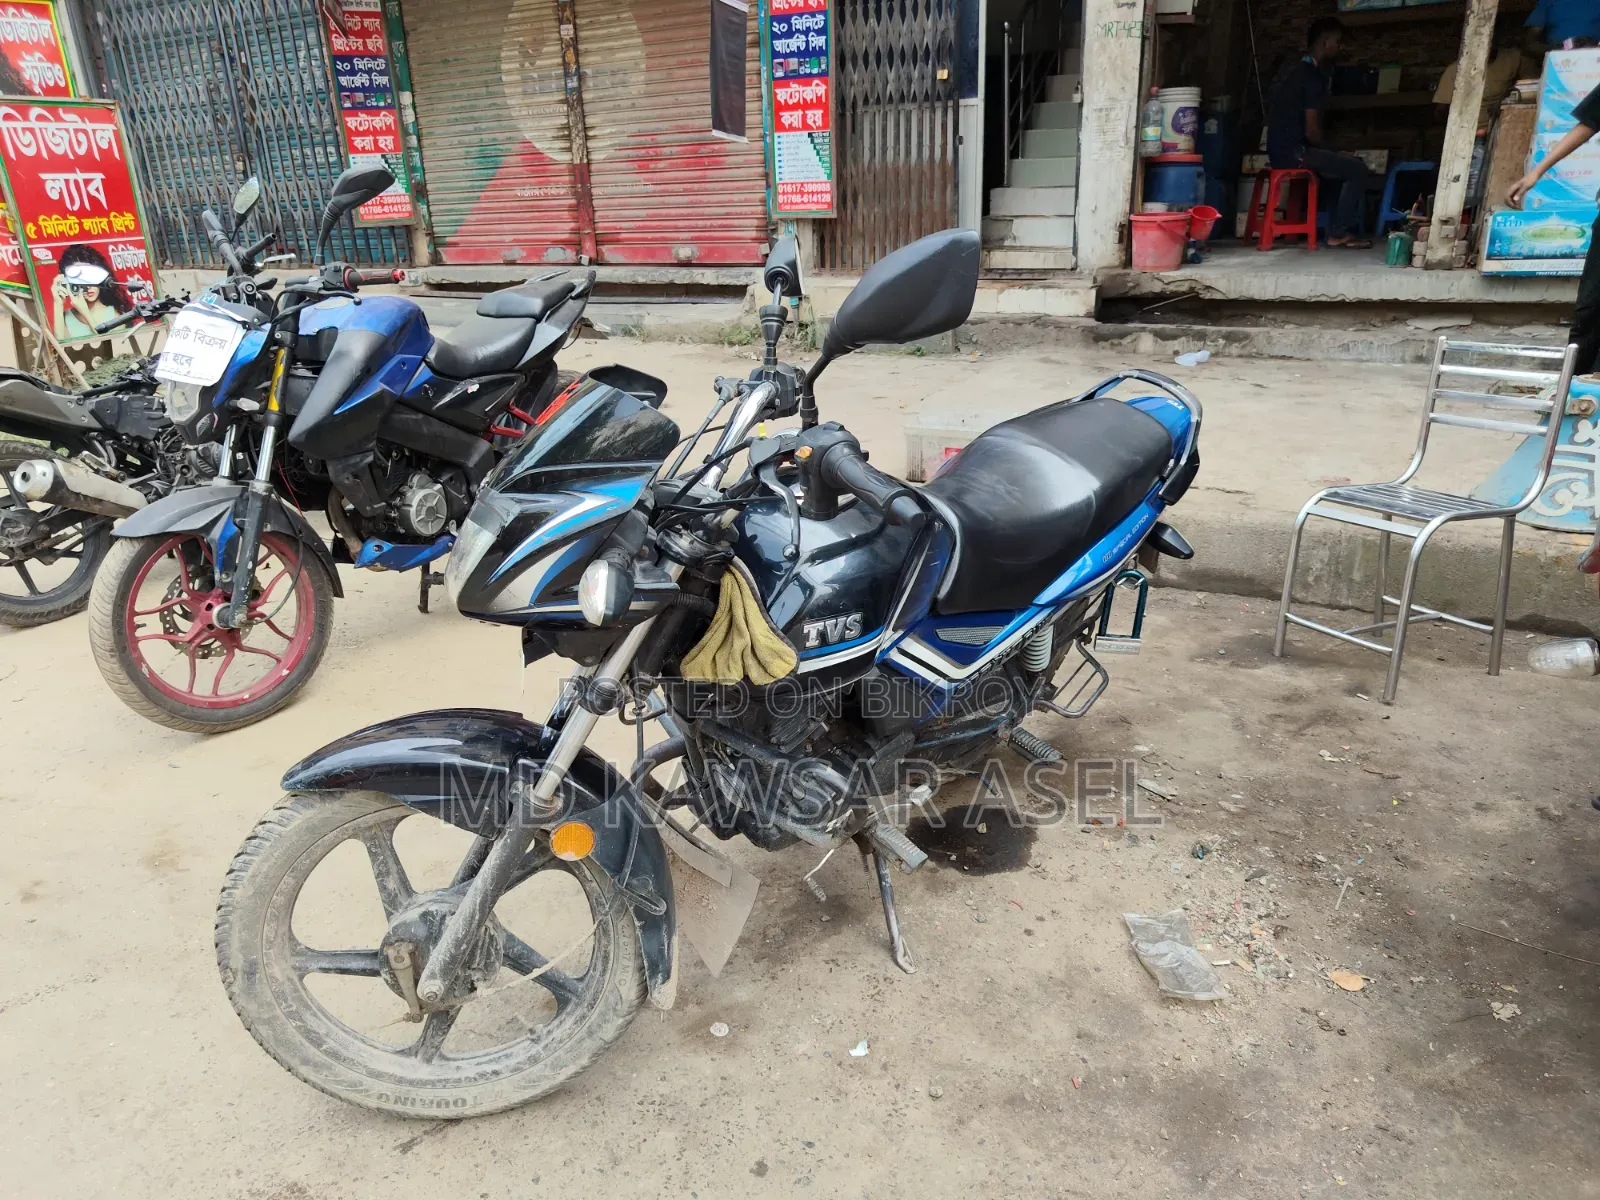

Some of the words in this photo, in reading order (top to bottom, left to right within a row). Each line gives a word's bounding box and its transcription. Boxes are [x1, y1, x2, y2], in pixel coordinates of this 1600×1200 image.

[771, 21, 788, 35] ২০
[790, 13, 826, 32] মিনিটে
[365, 34, 384, 53] ছবি
[772, 32, 807, 54] আর্জেন্ট
[808, 31, 827, 51] সিল
[335, 60, 351, 72] ২০
[352, 57, 387, 71] মিনিটে
[337, 71, 370, 88] আর্জেন্ট
[371, 71, 390, 88] সিল
[774, 79, 828, 106] ফটোকপি
[345, 111, 395, 133] ফটোকপি
[778, 108, 804, 130] করা
[804, 109, 824, 130] হয়
[0, 106, 121, 162] ডিজিটাল
[351, 135, 375, 152] করা
[376, 135, 395, 152] হয়
[37, 166, 109, 212] ল্যাব
[26, 222, 38, 239] ৫
[38, 213, 80, 239] মিনিটে
[81, 216, 109, 236] ল্যাব
[109, 211, 136, 234] প্রিন্ট
[108, 243, 150, 272] ডিজিটাল
[172, 351, 195, 368] হবে
[1131, 512, 1150, 534] EDITION
[803, 612, 864, 649] TVS
